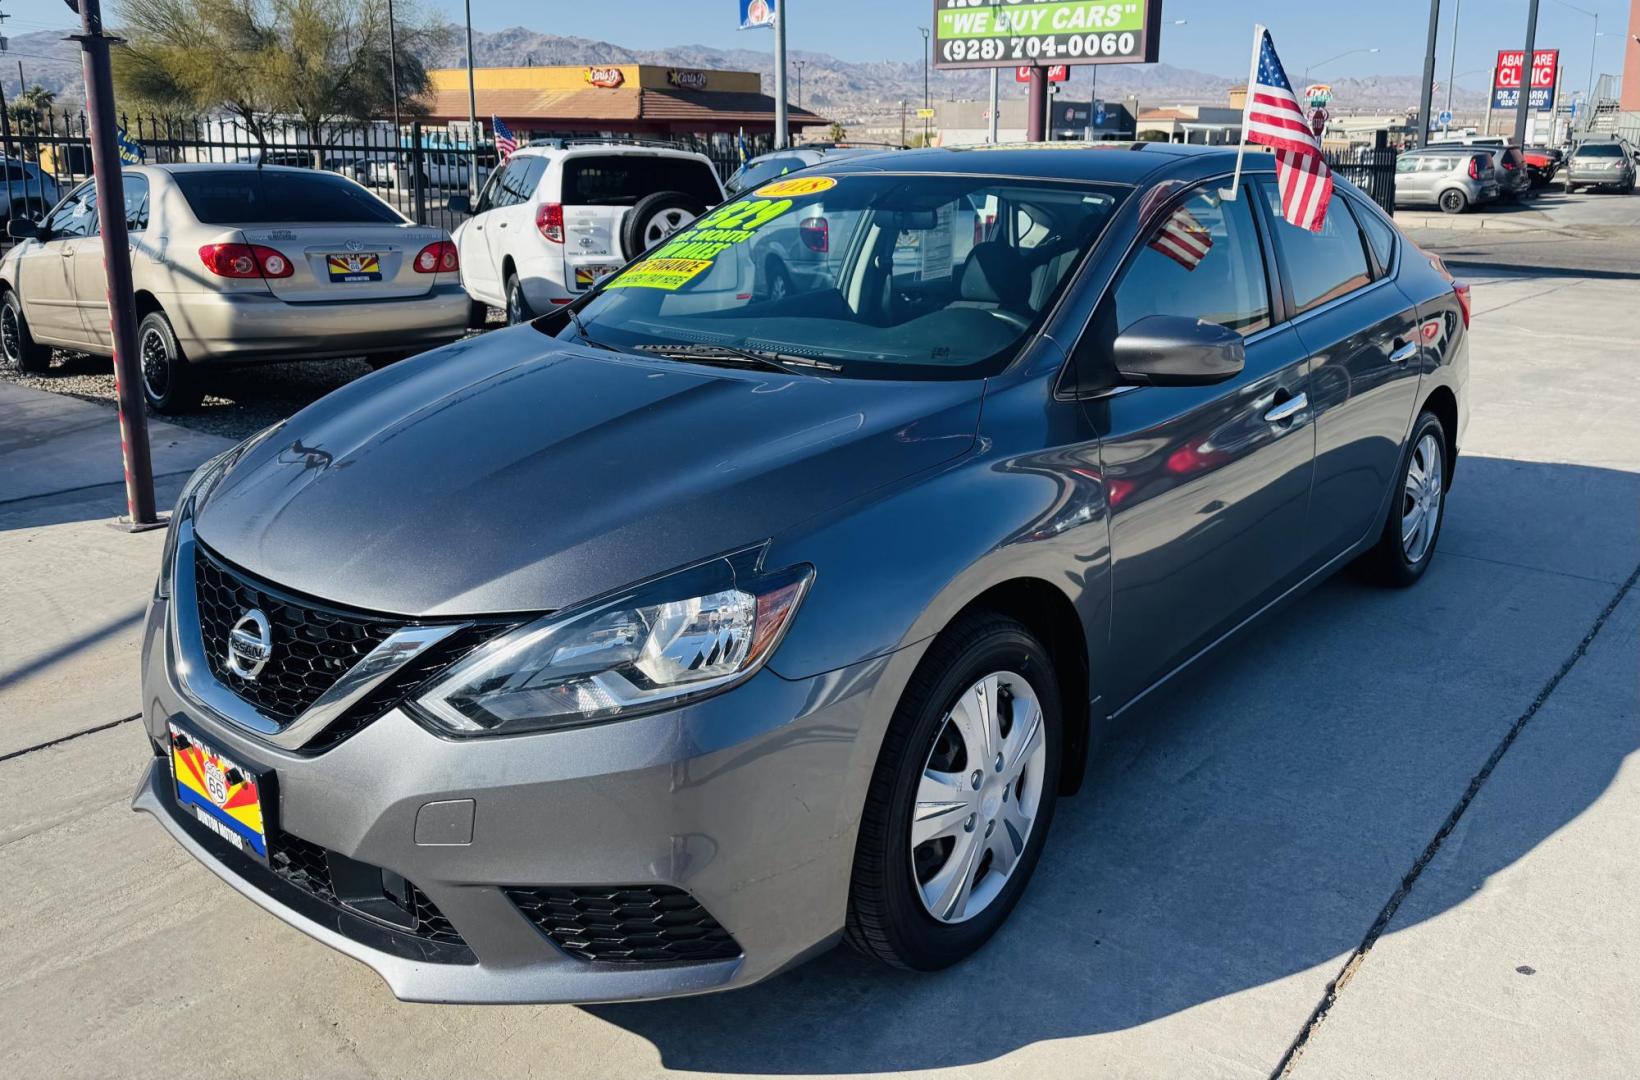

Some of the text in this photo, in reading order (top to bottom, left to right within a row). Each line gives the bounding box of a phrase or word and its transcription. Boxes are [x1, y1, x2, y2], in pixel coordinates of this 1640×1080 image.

[943, 4, 1137, 34] "WE BUY CARS"
[943, 32, 1135, 61] (928) 704-0060
[1499, 67, 1551, 85] CLIC
[690, 229, 756, 244] MONTH
[231, 635, 266, 660] NISSAN
[208, 776, 224, 800] 66
[219, 820, 243, 850] MOTORS
